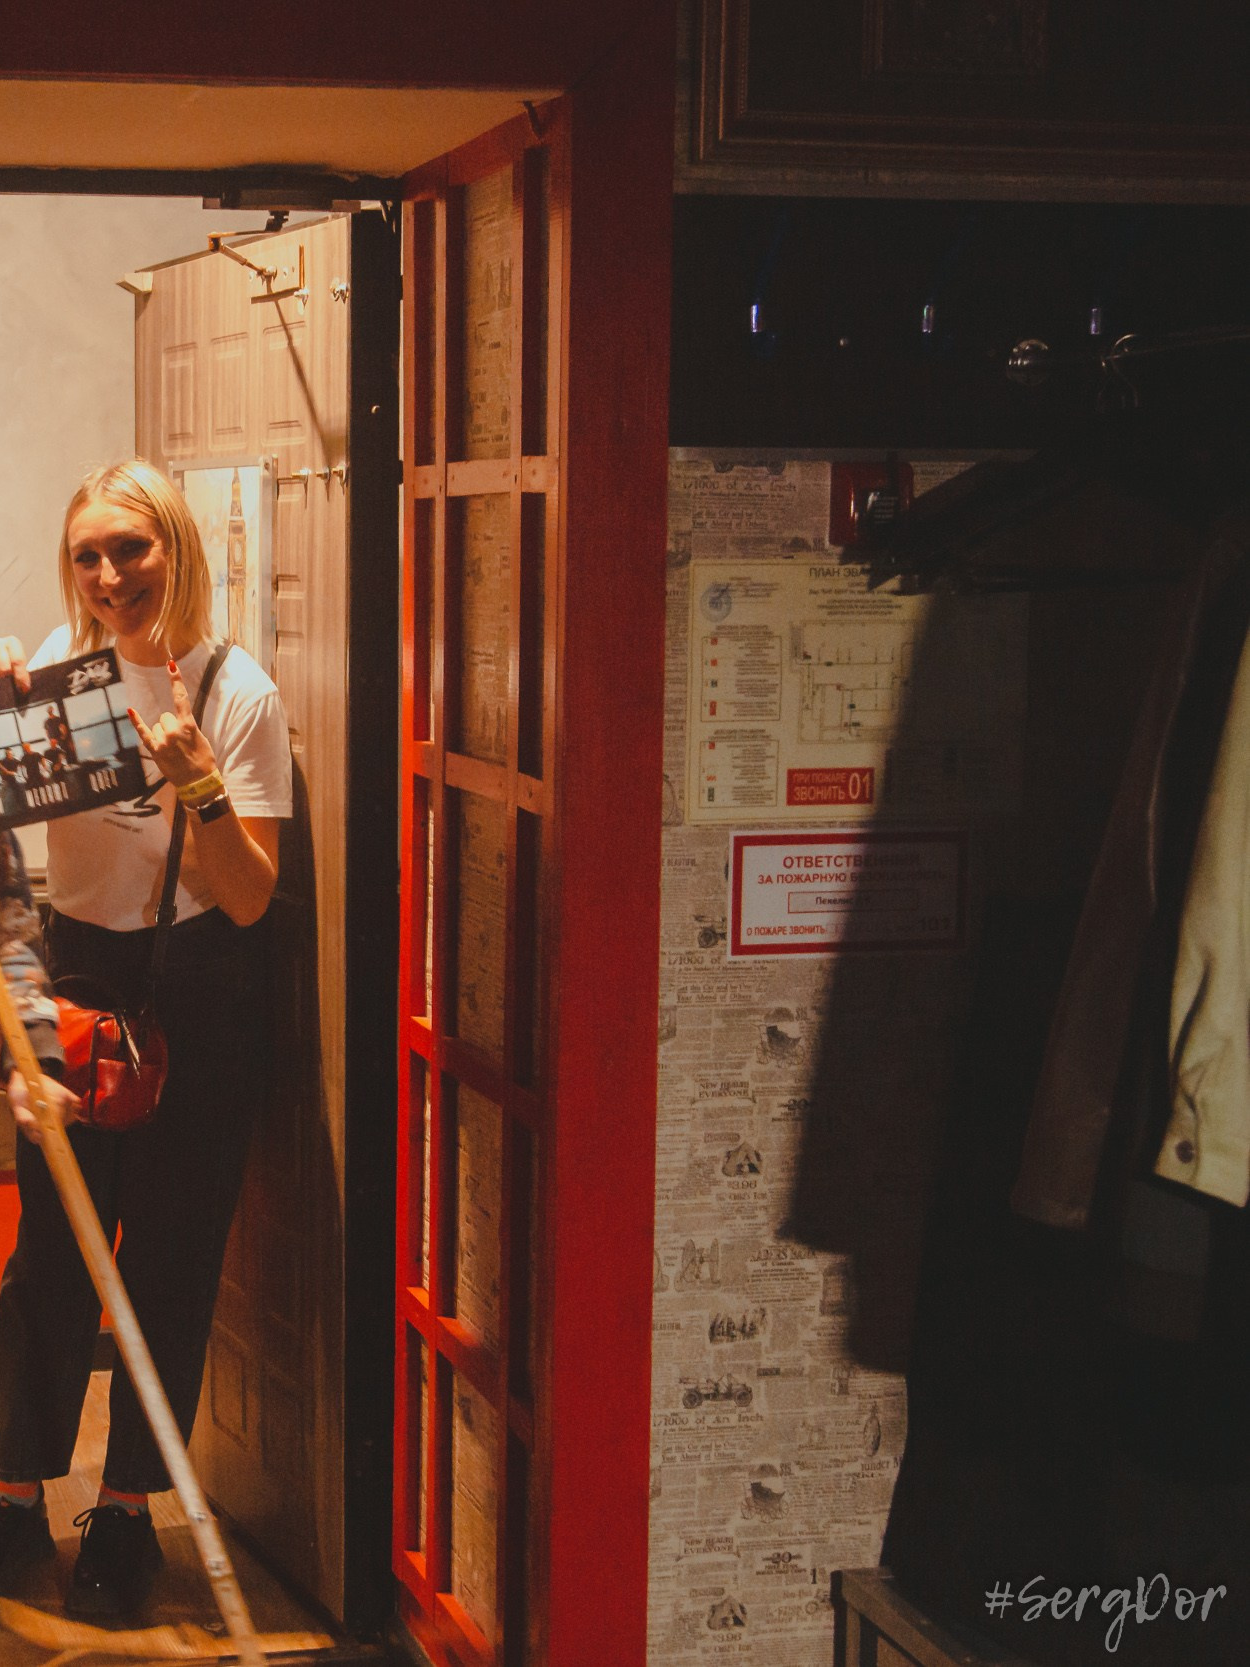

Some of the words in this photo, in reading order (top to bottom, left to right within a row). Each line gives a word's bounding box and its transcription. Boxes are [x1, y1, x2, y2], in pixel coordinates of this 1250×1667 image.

[809, 567, 840, 578] ПЛАН
[793, 773, 811, 784] ПРИ
[811, 772, 847, 783] ПОЖАРЕ
[849, 771, 871, 800] 01
[793, 785, 846, 801] ЗВОНИТЬ
[758, 874, 774, 885] ЗА
[776, 872, 847, 885] ПОЖАРНУЮ
[746, 927, 753, 937] О
[754, 926, 788, 937] ПОЖАРЕ
